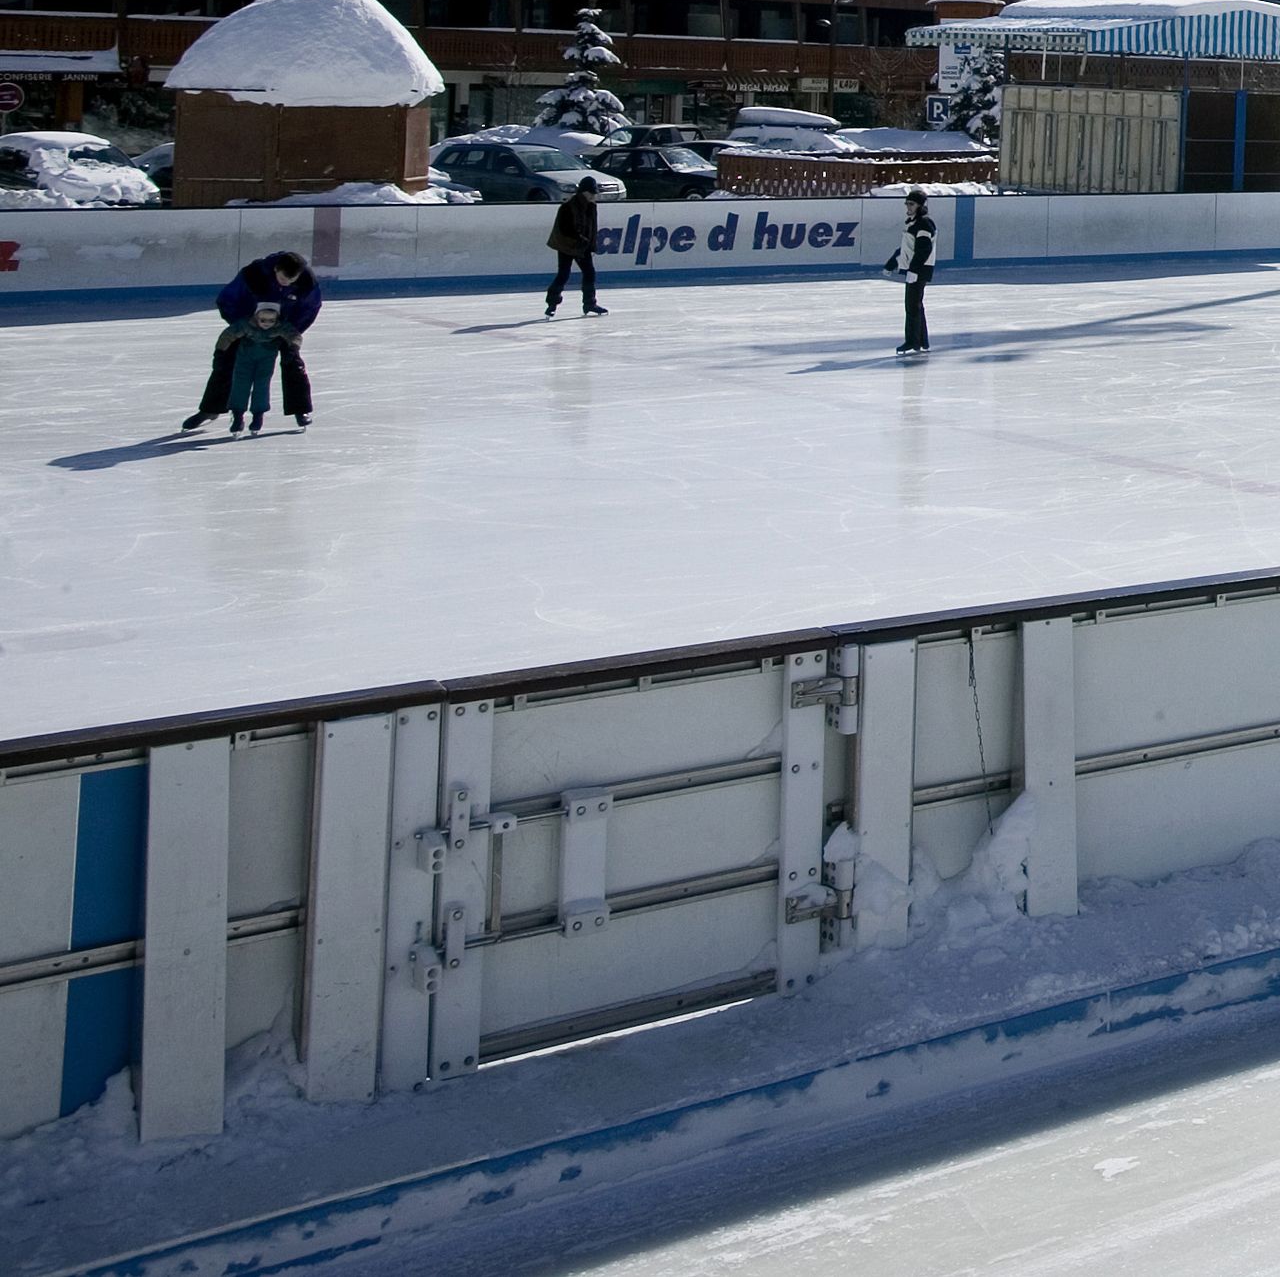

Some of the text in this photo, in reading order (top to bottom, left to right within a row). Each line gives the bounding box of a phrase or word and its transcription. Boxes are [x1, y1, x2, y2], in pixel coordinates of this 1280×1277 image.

[61, 74, 98, 82] JANNIN
[933, 102, 944, 118] P
[595, 214, 697, 265] alpe
[752, 211, 860, 251] huez
